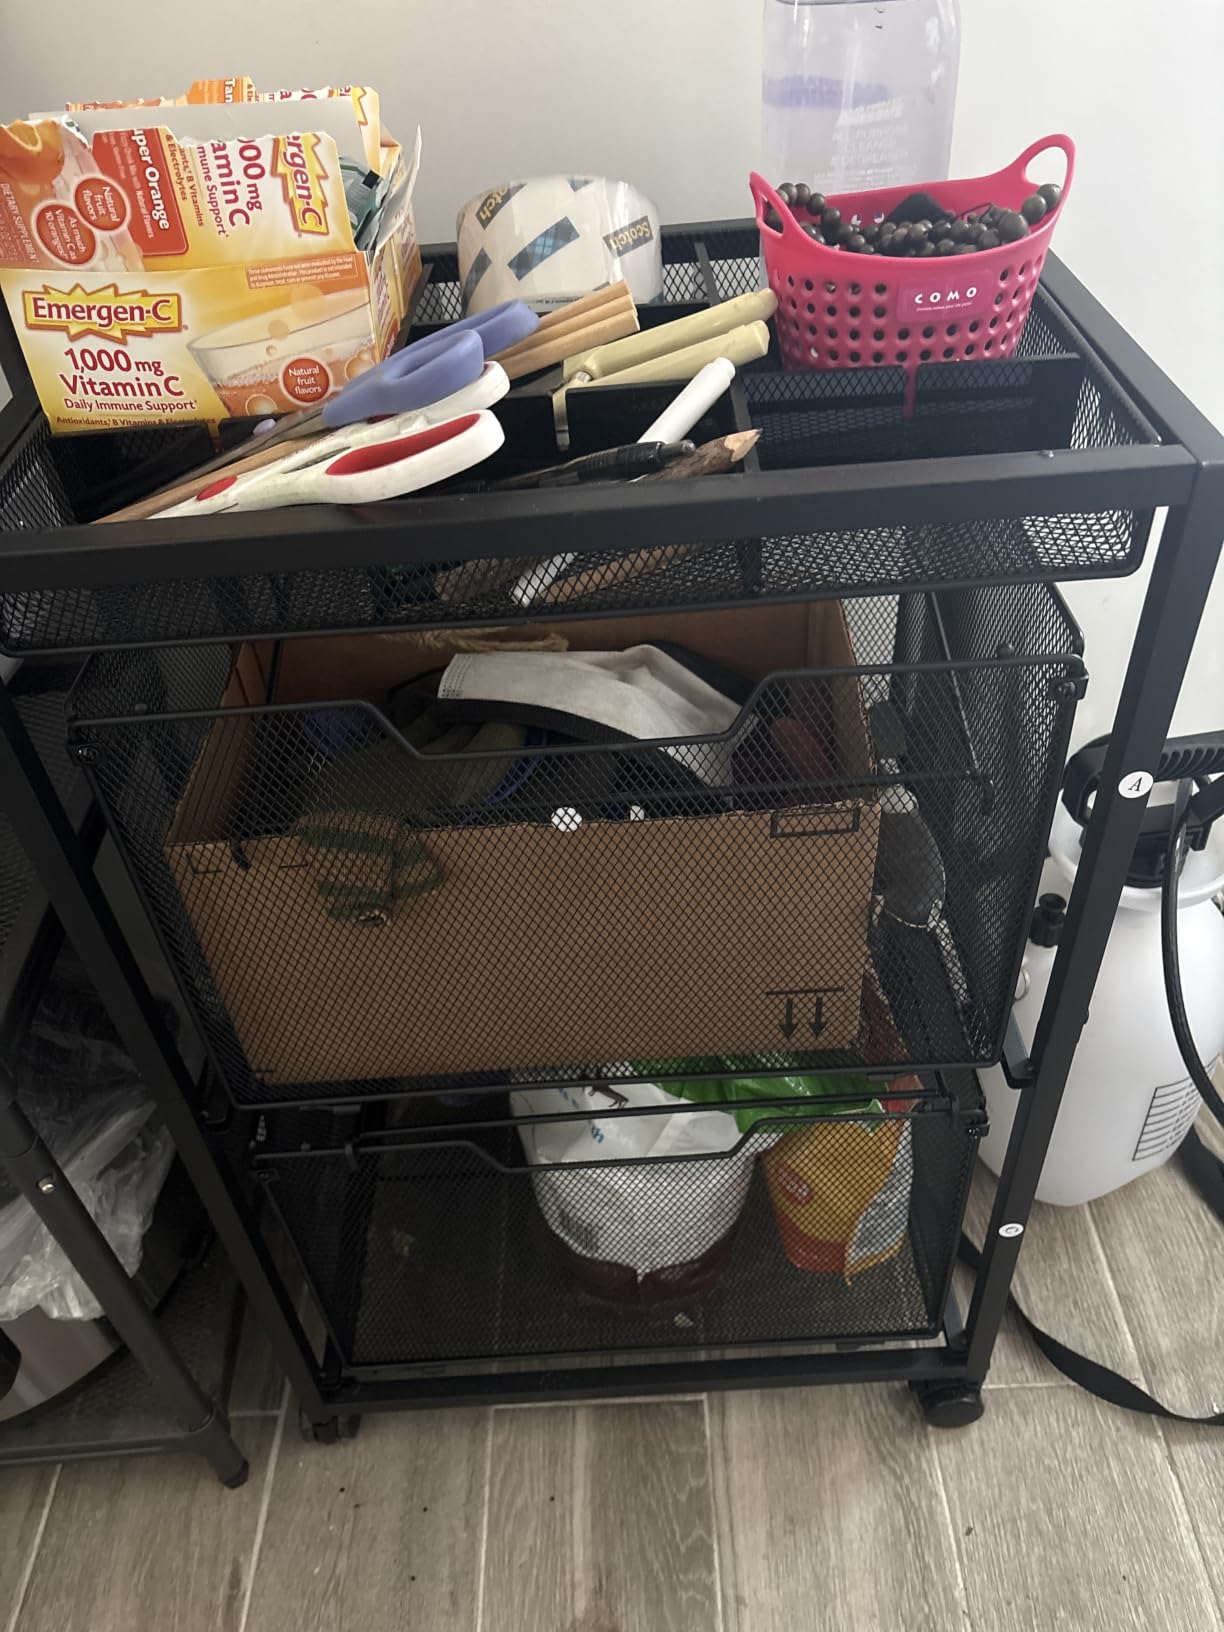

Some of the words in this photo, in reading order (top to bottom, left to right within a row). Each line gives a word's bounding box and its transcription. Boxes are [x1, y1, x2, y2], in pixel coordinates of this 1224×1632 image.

[168, 143, 188, 202] Electrolytes
[186, 175, 194, 183] B
[82, 189, 97, 221] flavors
[94, 195, 106, 216] fruit
[102, 186, 120, 223] Natural
[145, 167, 170, 230] Orange
[189, 183, 205, 227] Vitamins
[246, 183, 263, 211] mg
[55, 209, 70, 243] Vitamin
[66, 242, 74, 252] C
[229, 207, 251, 227] C
[15, 215, 40, 263] SUPPLEMENT
[68, 216, 77, 228] As
[73, 228, 87, 252] much
[608, 220, 652, 251] Scotch
[914, 286, 978, 304] COMO
[31, 297, 173, 328] Emergen-C
[64, 347, 133, 374] 1,000
[134, 359, 164, 376] mg
[288, 365, 321, 377] Natural
[58, 372, 162, 397] Vitamin
[163, 375, 185, 397] C
[294, 384, 322, 395] flavors
[296, 375, 316, 385] fruit
[64, 398, 94, 413] Daily
[95, 399, 144, 411] Immune
[1128, 776, 1143, 791] A
